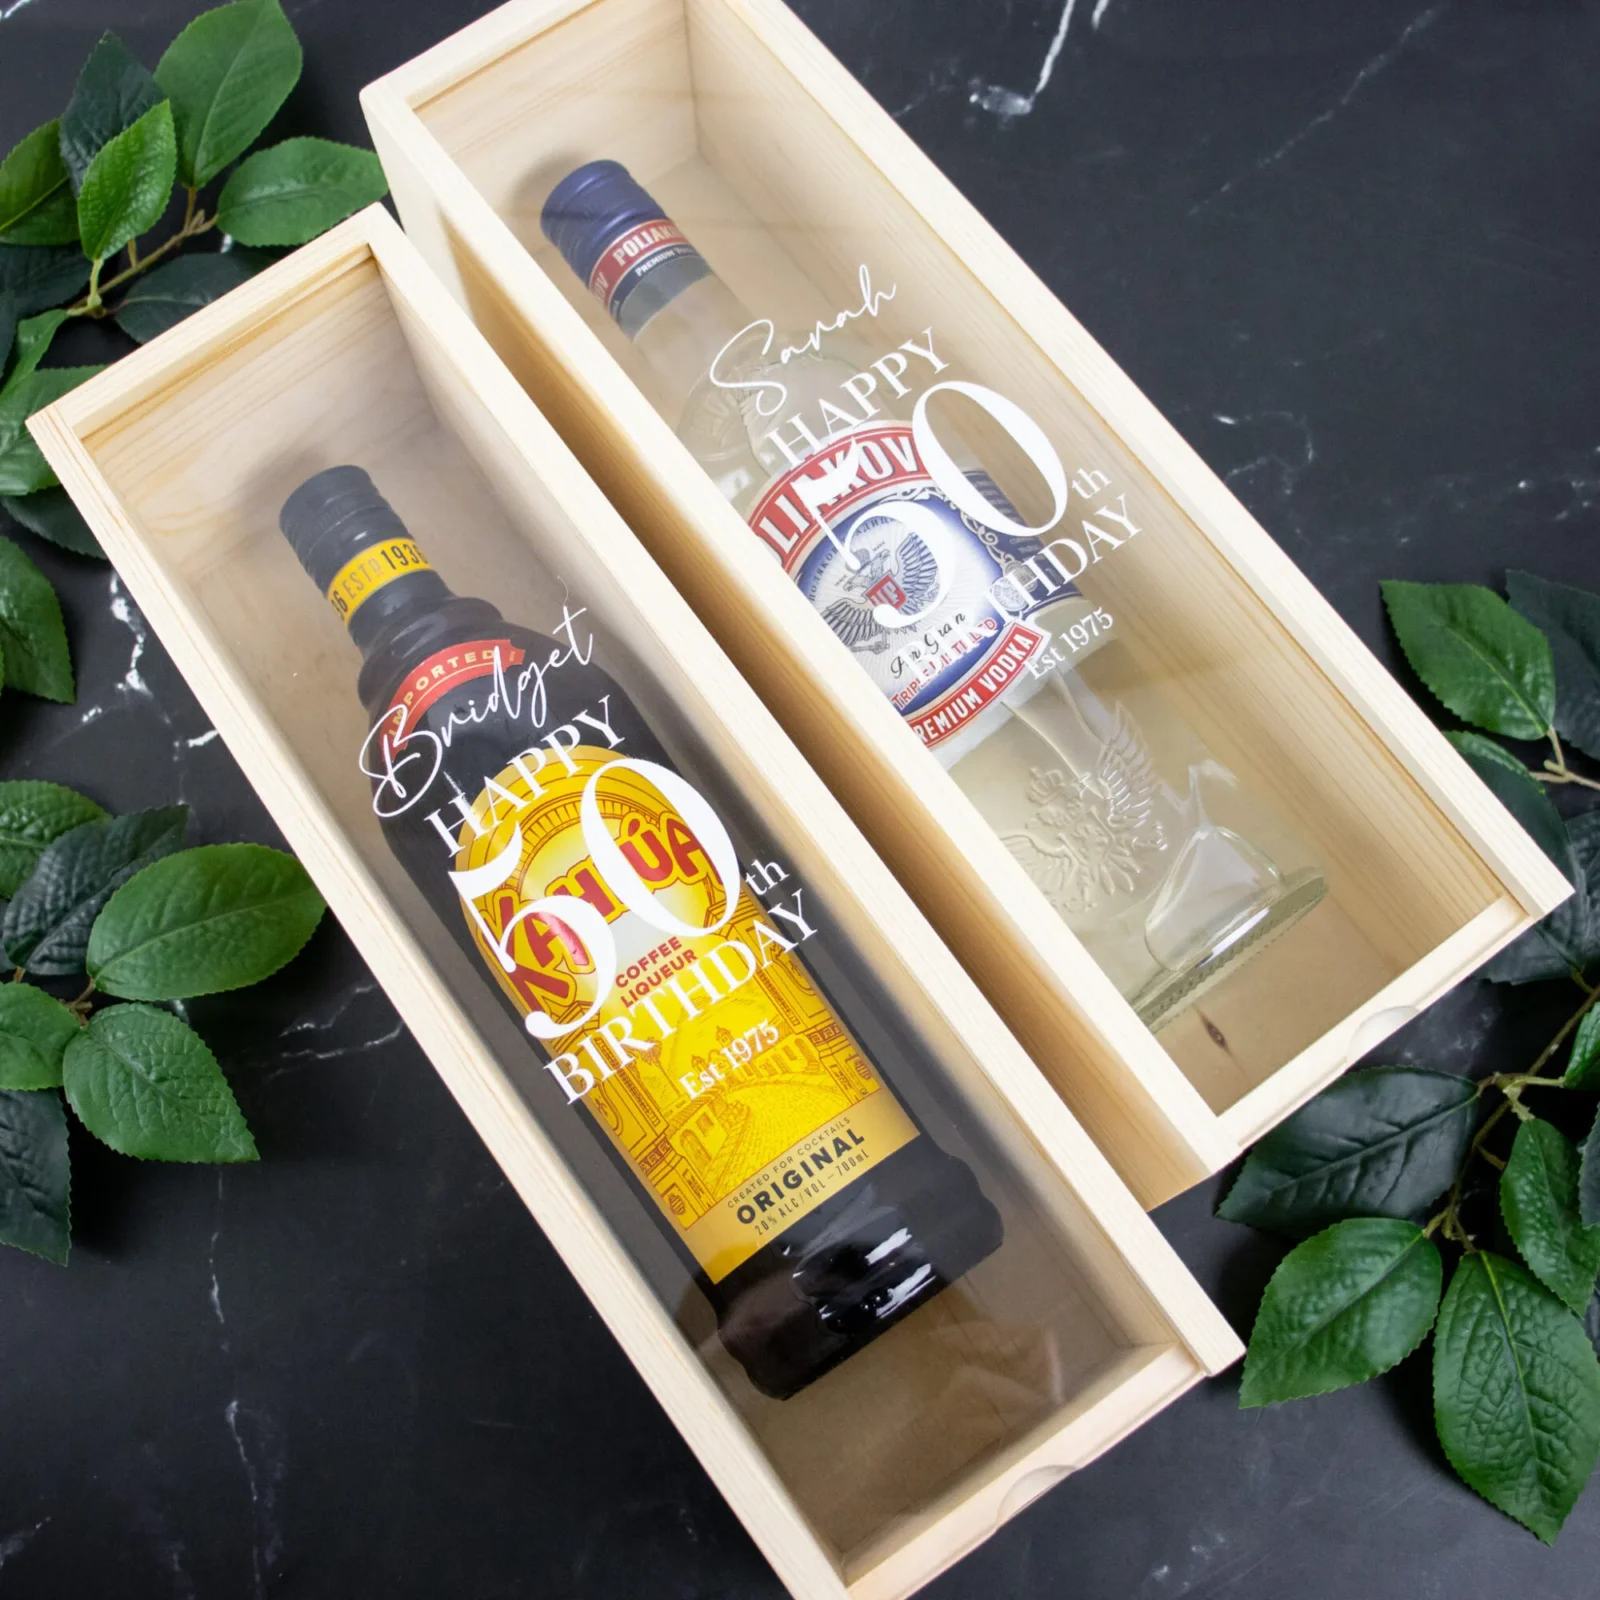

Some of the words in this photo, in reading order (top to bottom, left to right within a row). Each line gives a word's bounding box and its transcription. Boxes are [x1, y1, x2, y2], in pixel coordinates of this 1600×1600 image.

[710, 264, 896, 416] Sarah
[764, 327, 949, 468] HAPPY
[978, 632, 1034, 693] VODKA
[1022, 645, 1065, 681] Est
[1059, 607, 1114, 654] 1975
[359, 605, 594, 818] Bridget
[424, 694, 626, 858] HAPPY
[542, 889, 818, 1105] BIRTHDAY
[615, 936, 683, 988] COFFEE
[620, 949, 698, 1008] LIQUEUR
[679, 1061, 727, 1099] Est
[720, 1018, 780, 1071] 1975
[727, 1173, 770, 1208] CREATED
[773, 1155, 795, 1174] FOR
[797, 1116, 851, 1156] COCKTAILS
[736, 1127, 866, 1225] ORIGINAL
[754, 1214, 779, 1236] 20%
